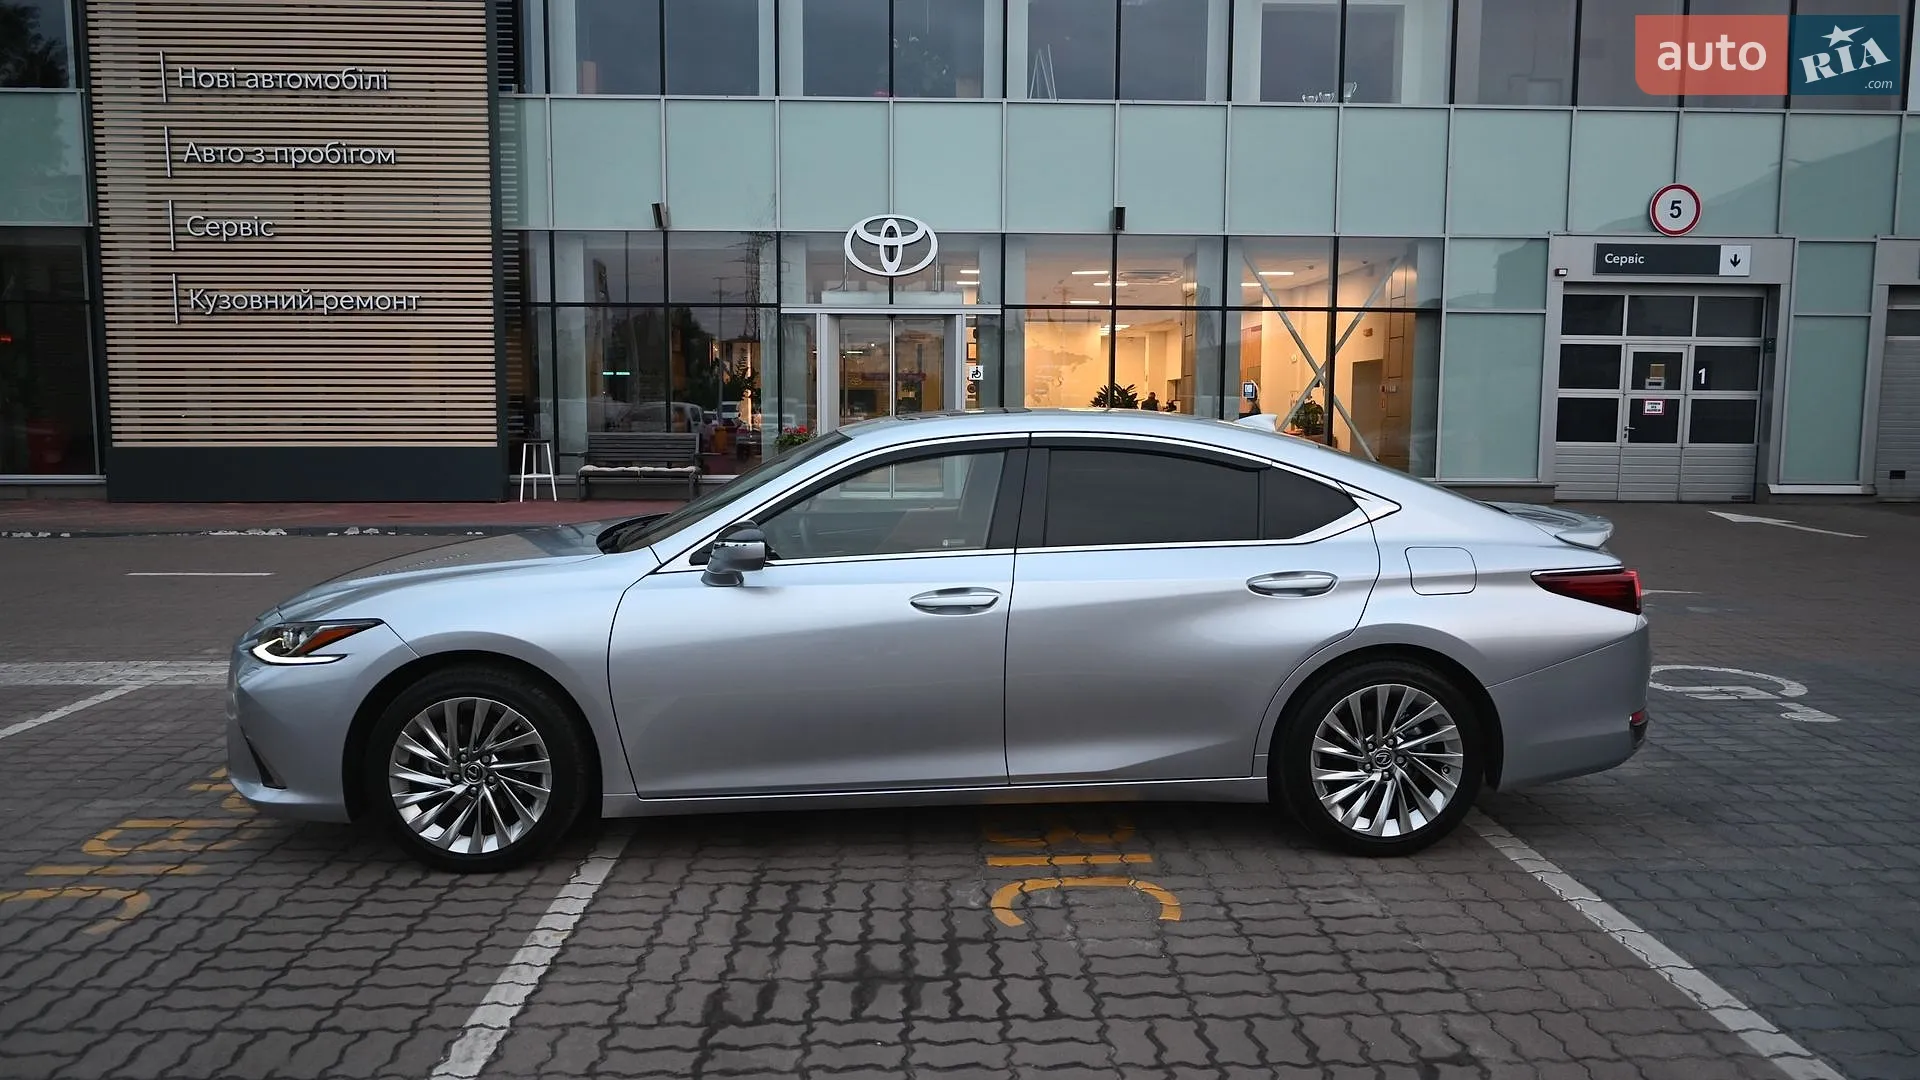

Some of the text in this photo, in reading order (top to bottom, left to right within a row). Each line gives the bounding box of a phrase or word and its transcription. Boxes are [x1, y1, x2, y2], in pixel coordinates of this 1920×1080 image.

[178, 66, 389, 91] Нові автомобілі
[183, 141, 396, 169] Авто з пробігом
[1669, 200, 1682, 219] 5
[186, 215, 275, 242] Сервіс
[1604, 252, 1645, 267] Сервіс
[188, 288, 421, 316] Кузовний ремонт
[1697, 367, 1706, 385] 1
